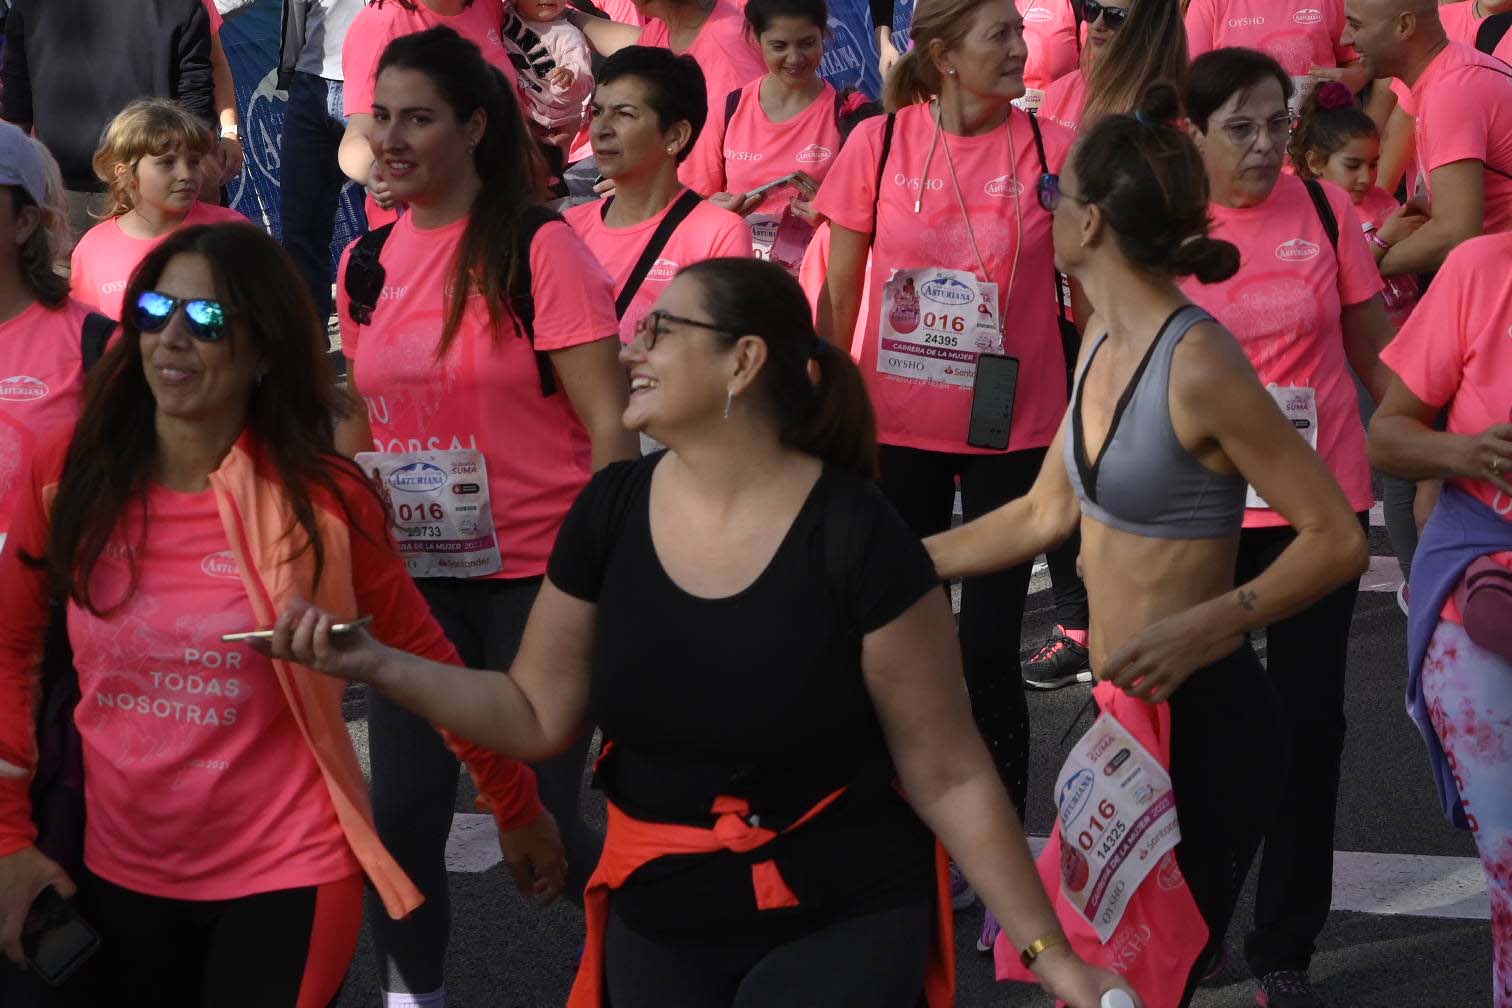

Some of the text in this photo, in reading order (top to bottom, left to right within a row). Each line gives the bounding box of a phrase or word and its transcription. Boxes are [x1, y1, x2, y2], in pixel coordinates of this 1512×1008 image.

[1228, 16, 1265, 29] OYSHO
[725, 150, 762, 161] OYSHO
[894, 173, 943, 191] OYSHO
[926, 286, 971, 302] ASTURIANA
[923, 312, 965, 332] 016
[924, 333, 958, 347] 24395
[892, 342, 926, 355] CARRERA
[938, 350, 948, 358] LA
[948, 352, 974, 361] MUJER
[888, 357, 925, 371] OYSHO
[393, 472, 443, 486] ASTURIANA
[399, 503, 444, 521] 016
[185, 649, 242, 669] POR
[151, 671, 241, 698] TODAS
[96, 692, 238, 726] NOSOTRAS
[1078, 799, 1117, 852] 016
[1096, 821, 1127, 860] 14325
[1102, 879, 1126, 925] OYSHO
